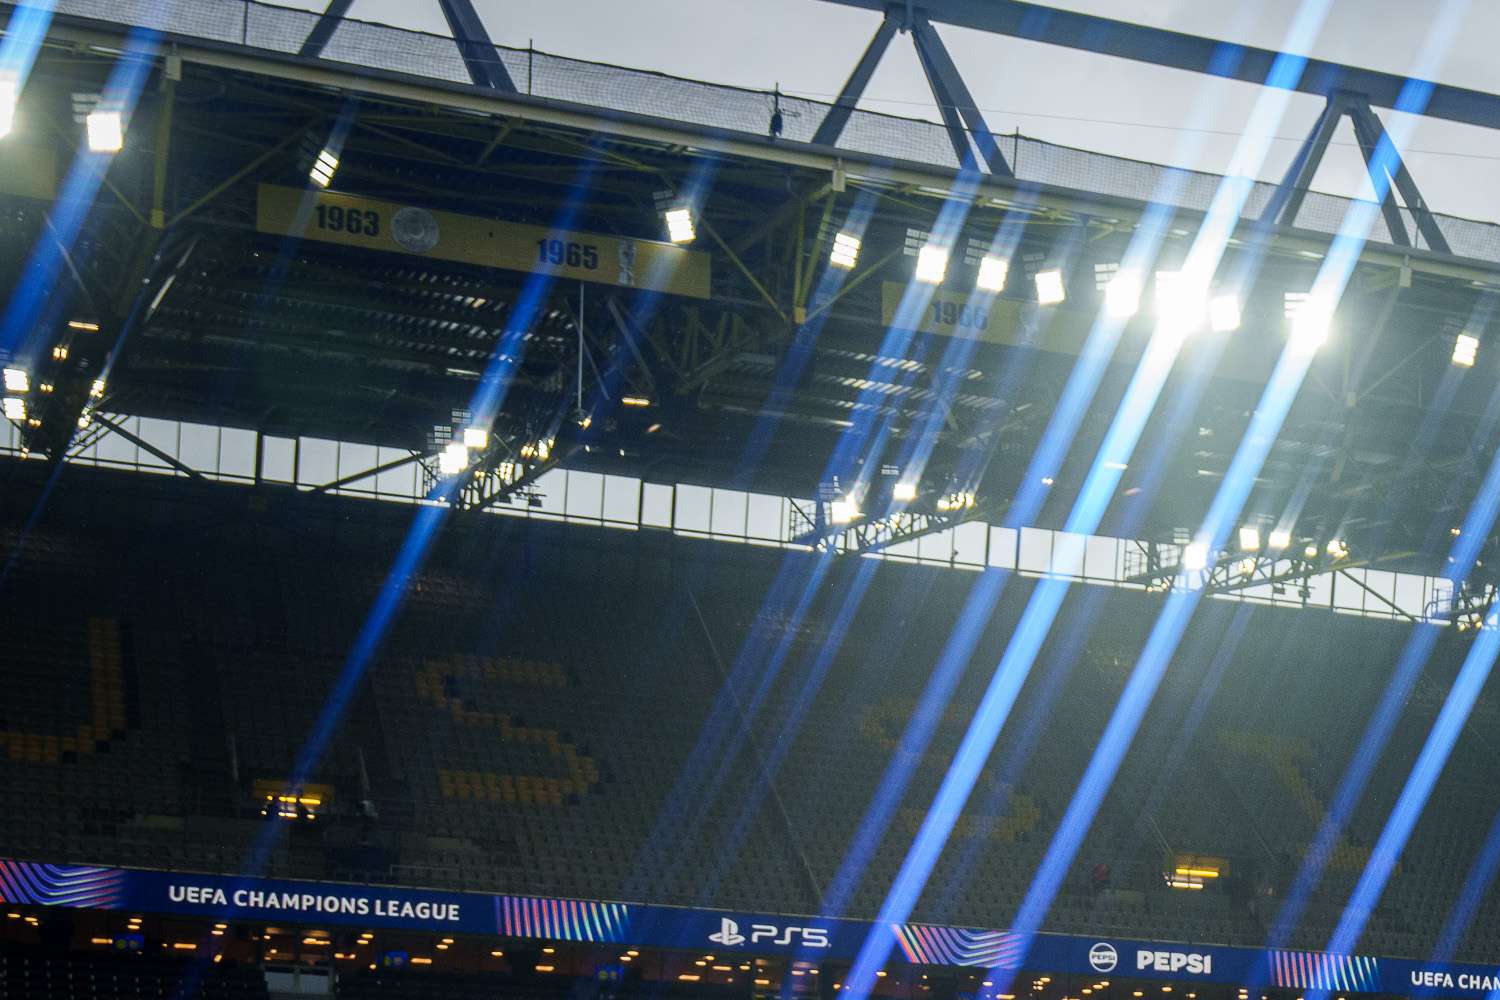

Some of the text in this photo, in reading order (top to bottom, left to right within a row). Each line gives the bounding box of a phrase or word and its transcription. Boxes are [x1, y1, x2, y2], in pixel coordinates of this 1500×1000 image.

[315, 204, 380, 237] 1963
[537, 237, 598, 271] 1965
[169, 885, 460, 921] UEFA CHAMPIONS LEAGUE
[751, 924, 828, 948] PS5
[1137, 950, 1211, 974] PEPSI
[1410, 970, 1454, 988] UEFA
